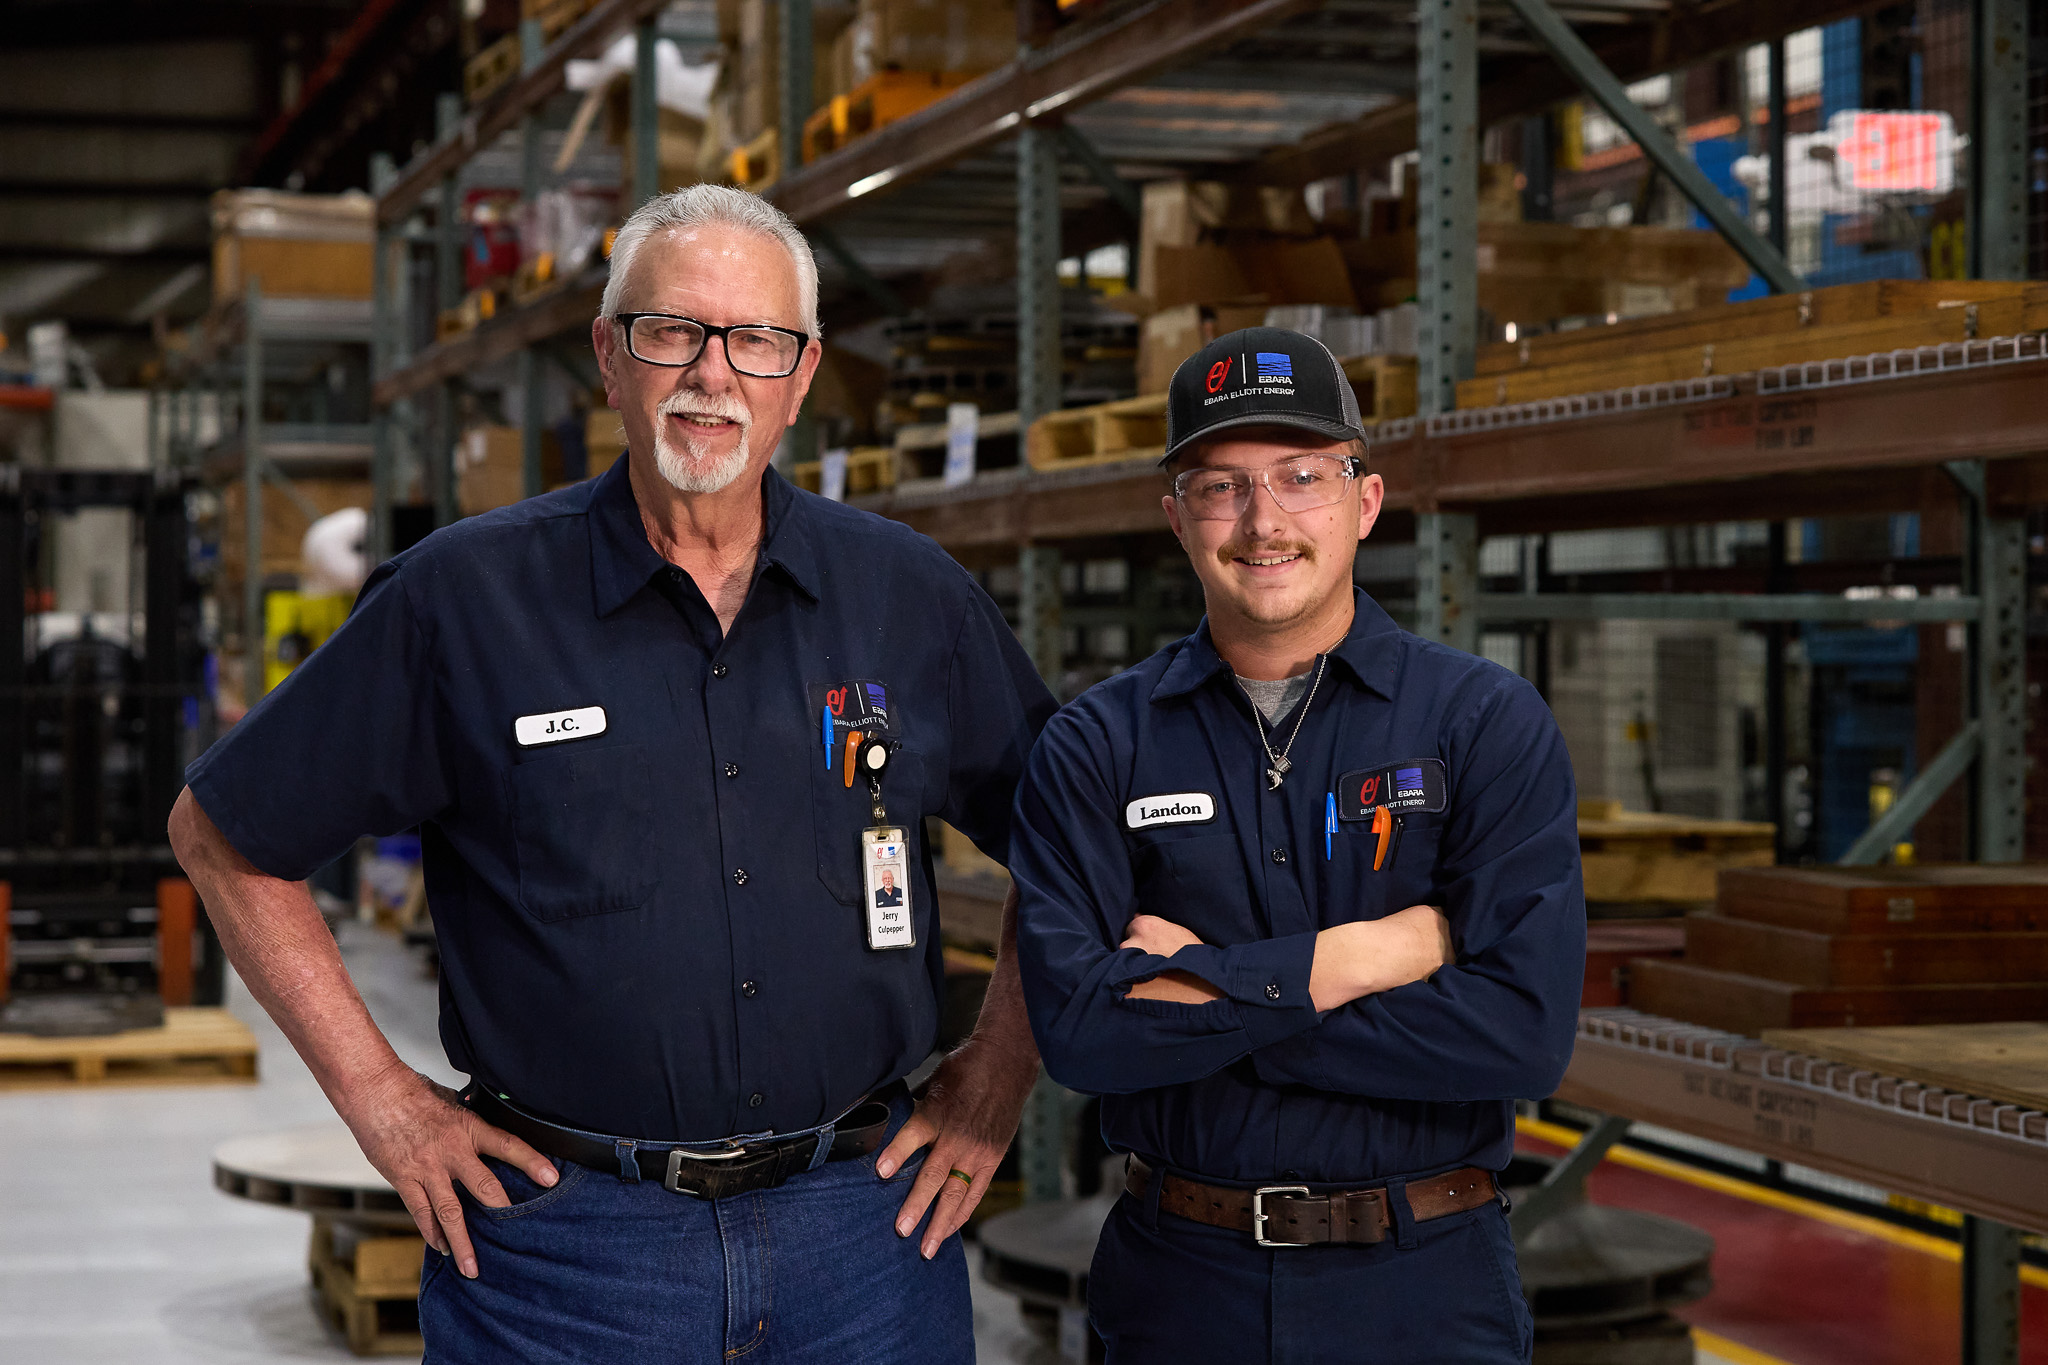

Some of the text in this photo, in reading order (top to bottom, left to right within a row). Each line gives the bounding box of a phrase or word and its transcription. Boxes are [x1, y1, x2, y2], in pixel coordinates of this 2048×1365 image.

[1259, 376, 1292, 384] EBARA
[1204, 387, 1295, 405] EBARA ELLIOTT ENERGY
[545, 717, 580, 734] J.C.
[851, 717, 877, 727] ELLIOTT
[1140, 802, 1203, 820] Landon
[1360, 806, 1377, 815] EBAR
[883, 912, 898, 921] Jerry
[878, 926, 904, 934] Culpepper
